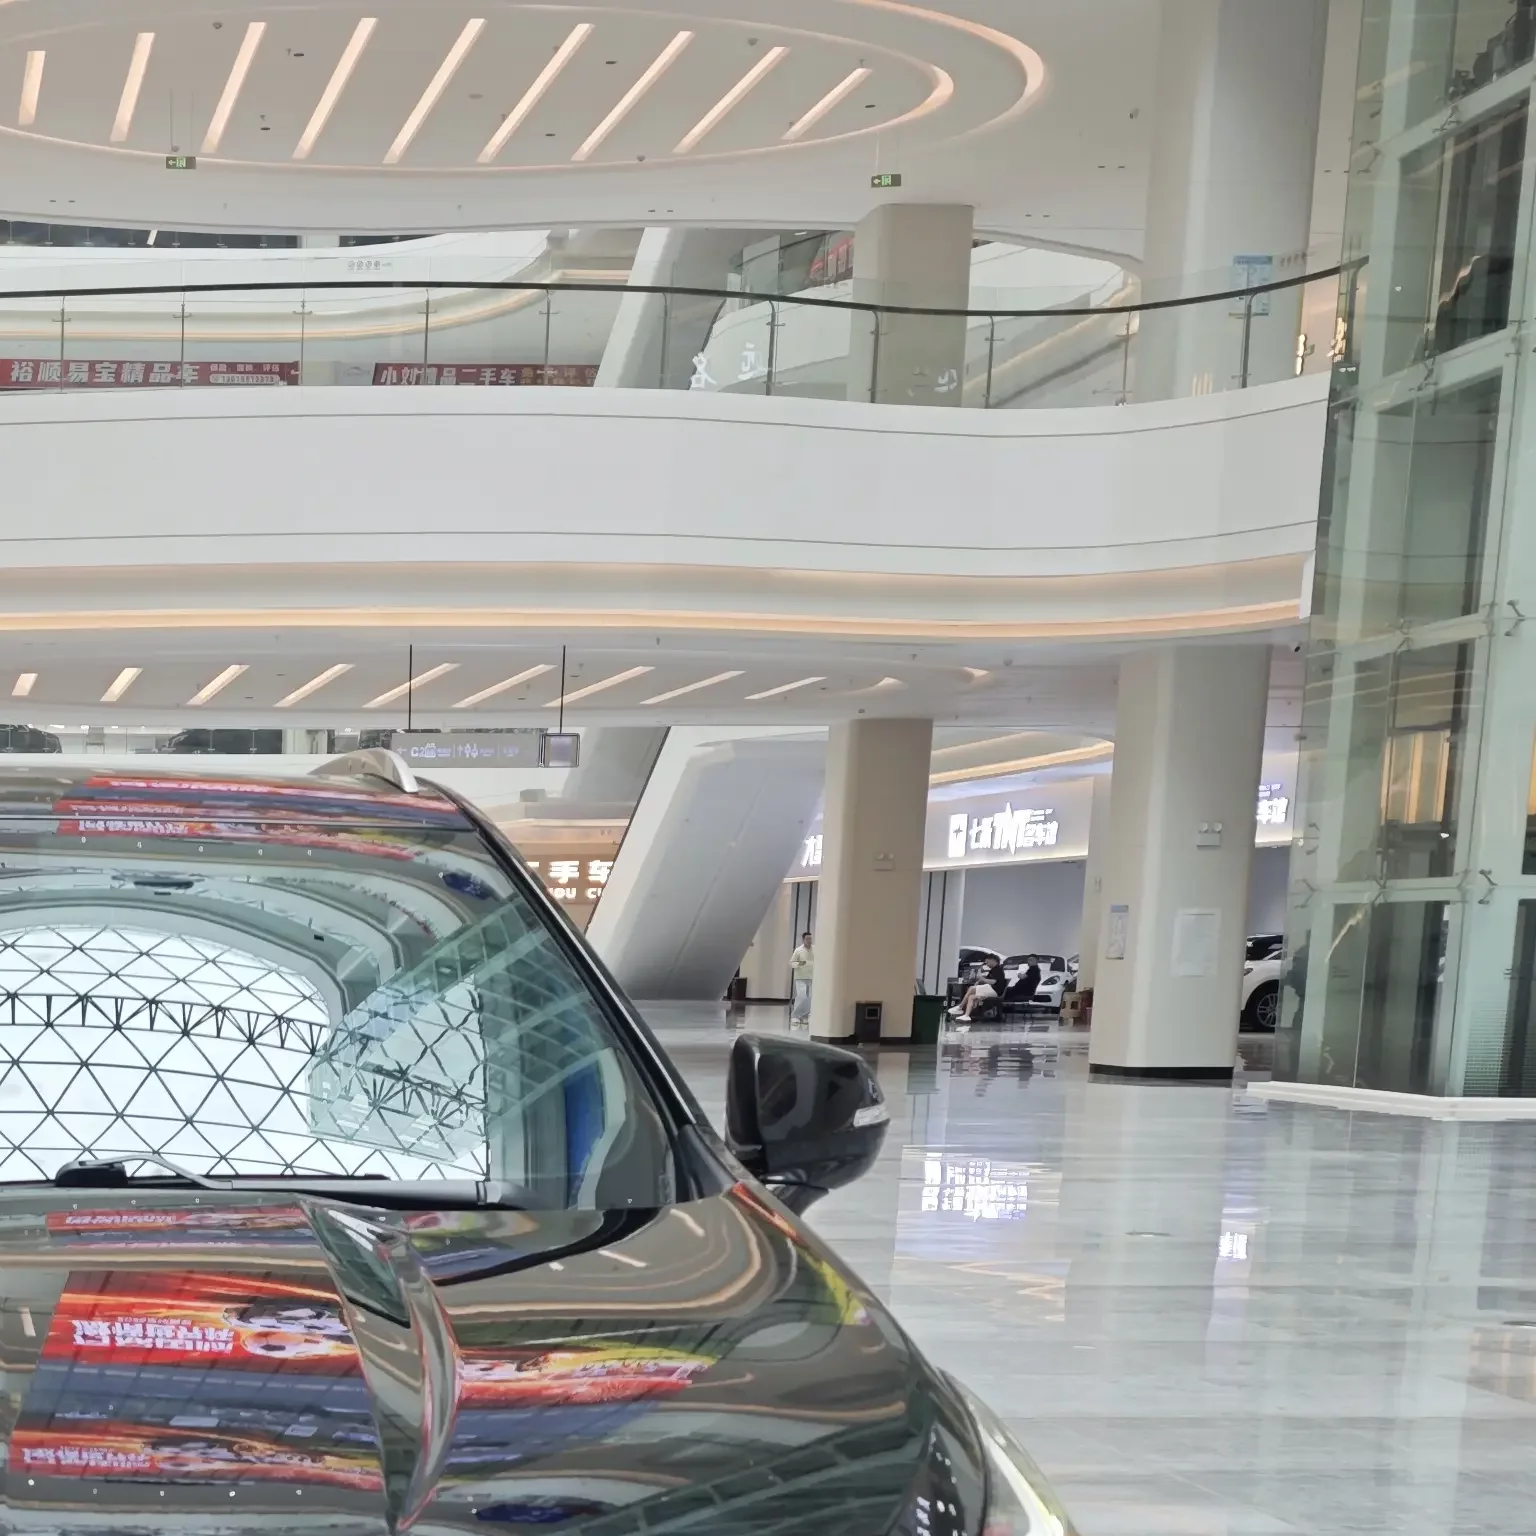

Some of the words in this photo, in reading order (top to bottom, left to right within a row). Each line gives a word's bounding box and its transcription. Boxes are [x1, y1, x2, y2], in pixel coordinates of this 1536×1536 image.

[10, 361, 200, 384] 裕顺易宝精品车
